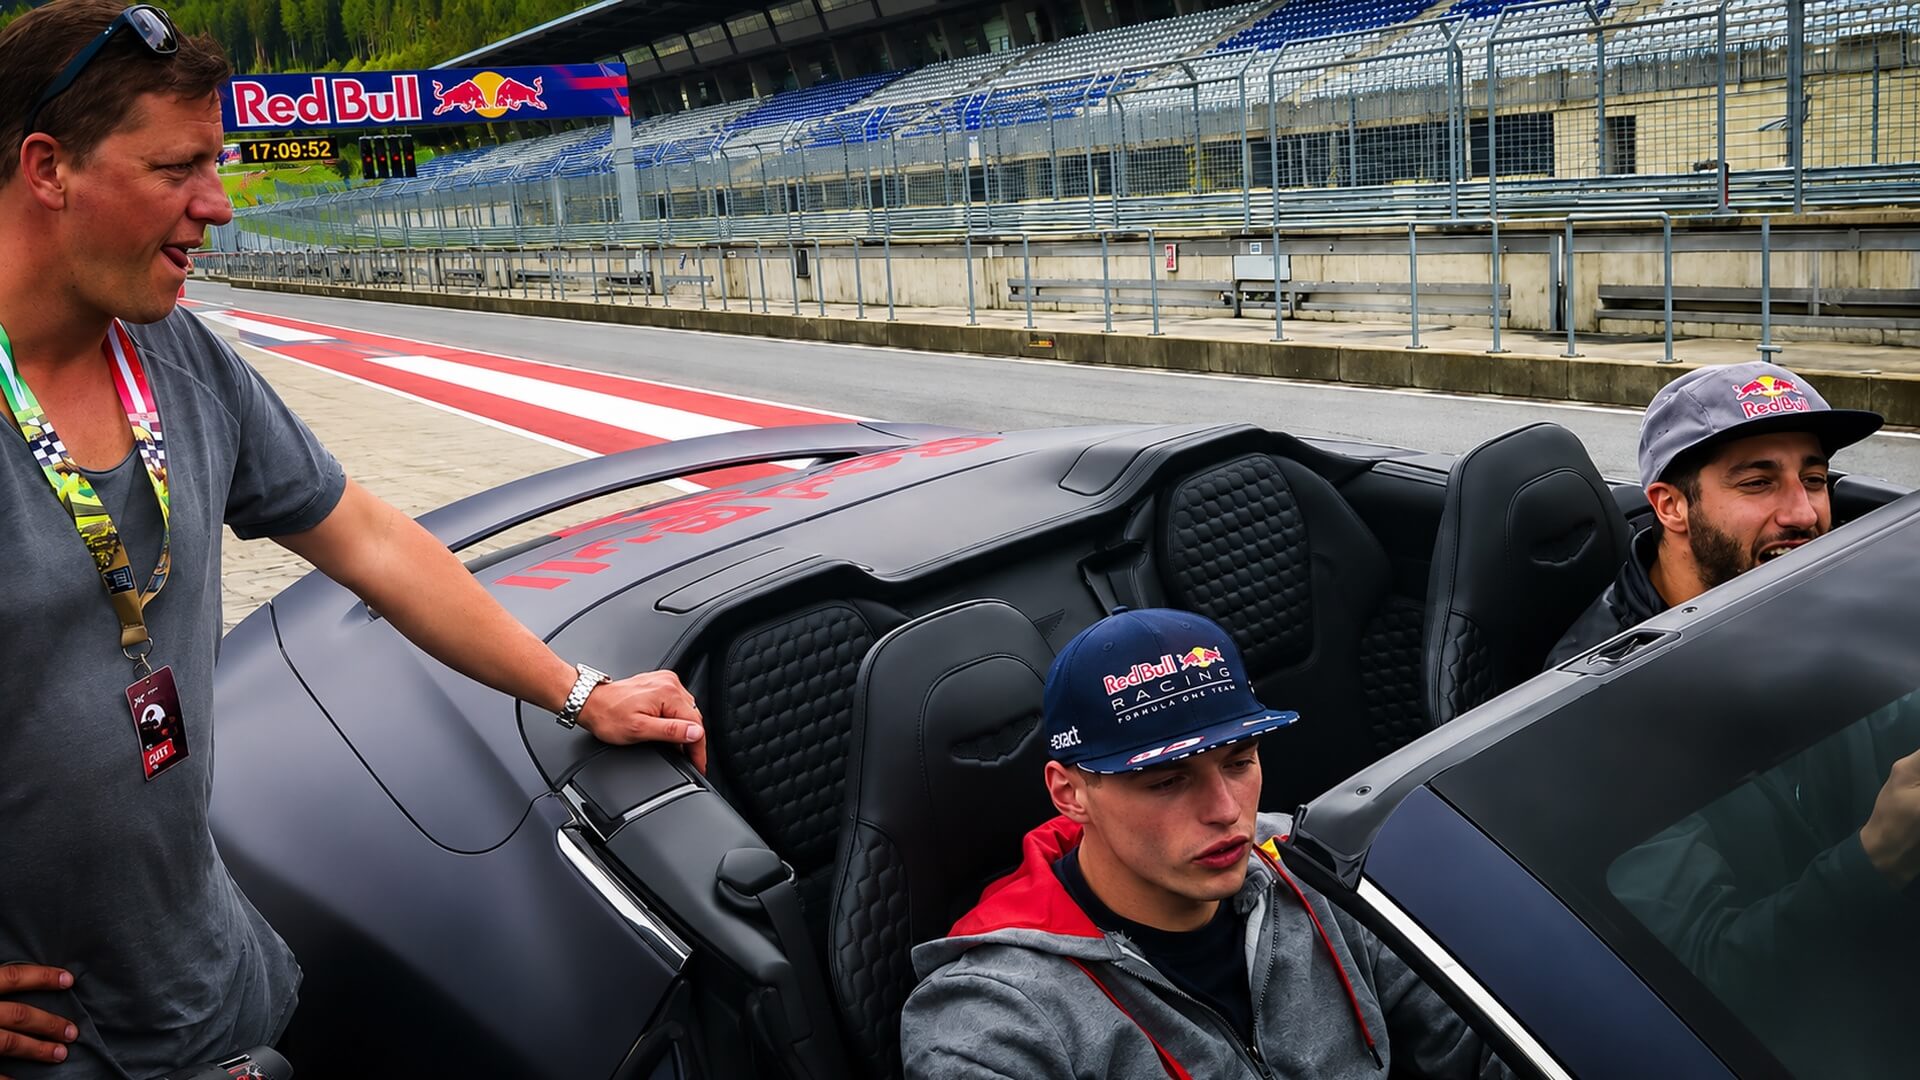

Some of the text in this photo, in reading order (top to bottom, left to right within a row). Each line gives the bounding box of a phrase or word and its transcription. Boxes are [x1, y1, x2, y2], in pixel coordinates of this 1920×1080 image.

[232, 74, 422, 127] Red Bull
[249, 141, 331, 160] 17:09:52
[1741, 396, 1781, 419] Red
[1104, 654, 1178, 695] Red Bull
[1111, 667, 1230, 710] RACING
[1118, 684, 1236, 723] FORMULA ONE TEAM
